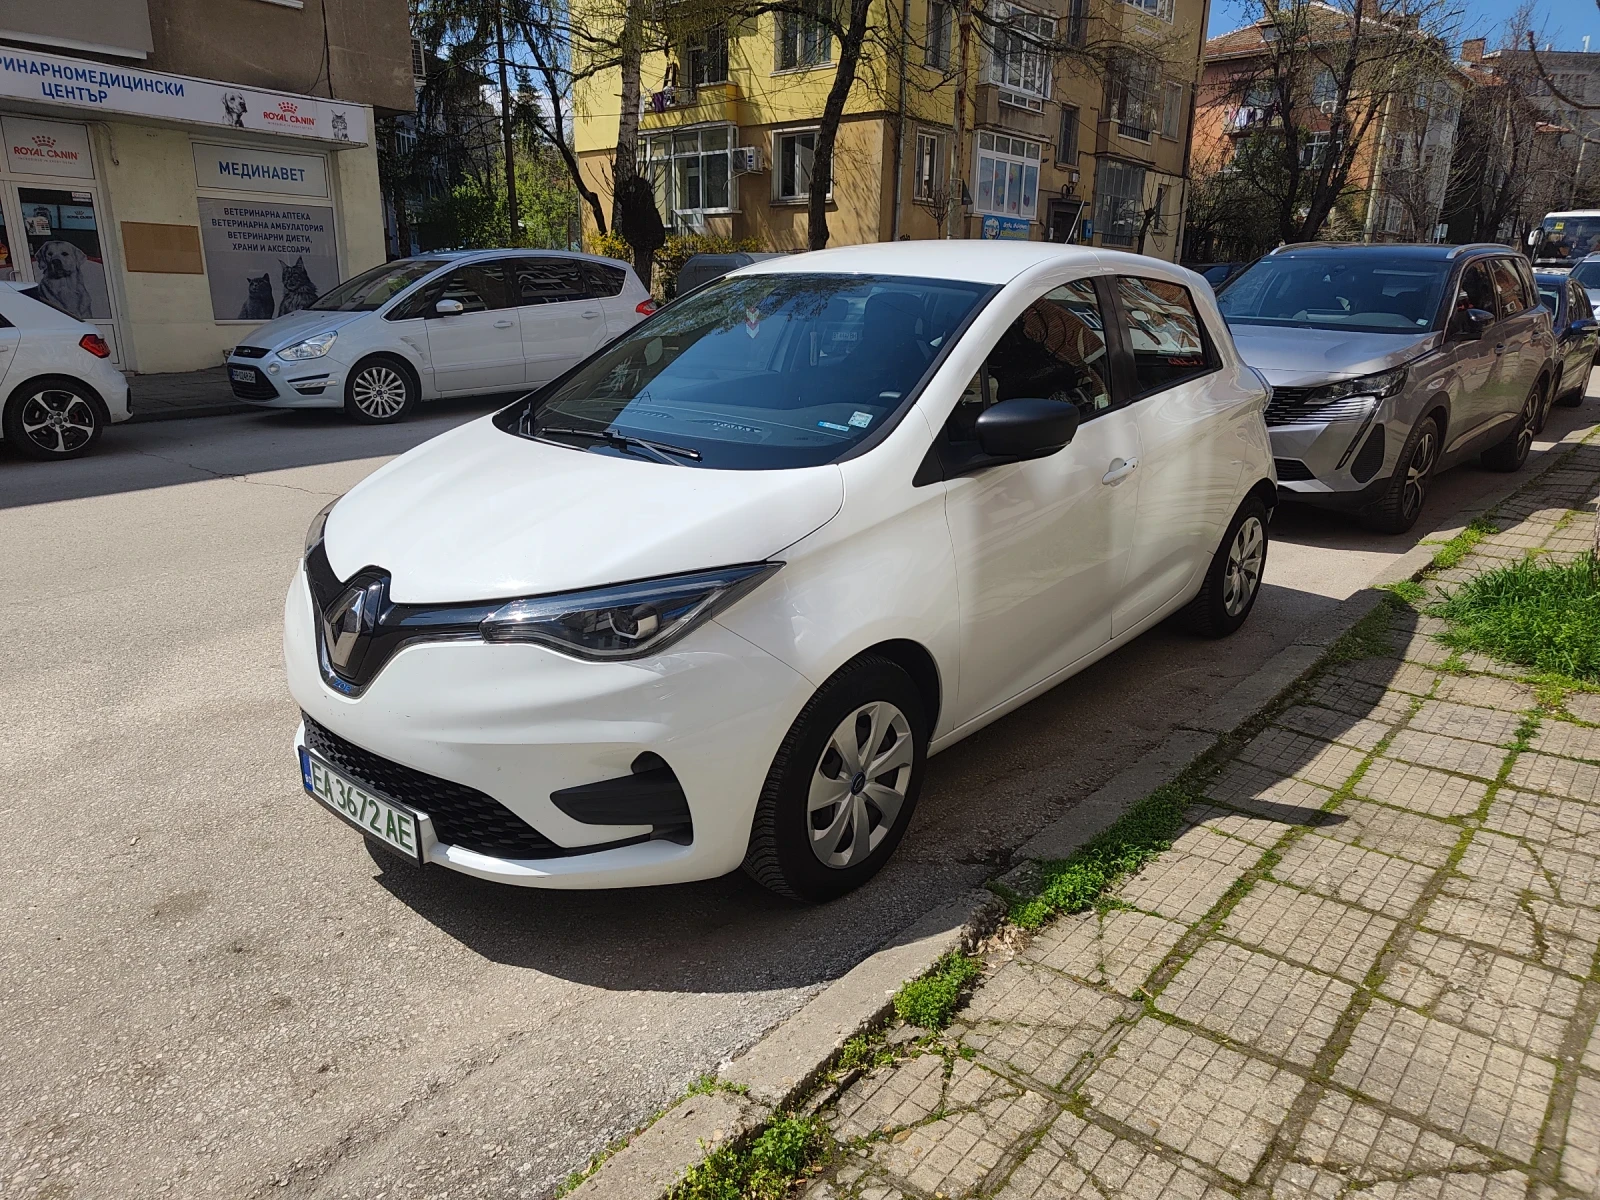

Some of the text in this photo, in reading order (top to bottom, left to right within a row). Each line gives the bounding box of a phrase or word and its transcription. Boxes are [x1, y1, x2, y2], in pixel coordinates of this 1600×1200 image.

[0, 56, 185, 97] ИНАРНОМЕДИЦИНСКИ
[41, 82, 108, 103] ЦЕНТЪР
[263, 111, 315, 126] ROYAL CANIN
[13, 146, 78, 160] ROYAL CANIN
[218, 160, 305, 182] МЕДИНАВЕТ
[224, 207, 311, 221] ВЕТЕРИНАРНА АПТЕКА
[212, 218, 324, 233] ВЕТЕРИНАРНА АМБУЛАТОРИЯ
[227, 231, 313, 244] ВЕТЕРИНАРНИ ДИЕТИ,
[232, 242, 258, 251] ХРАНИ
[267, 244, 311, 254] АКСЕСОАРИ
[333, 679, 352, 694] ZOE
